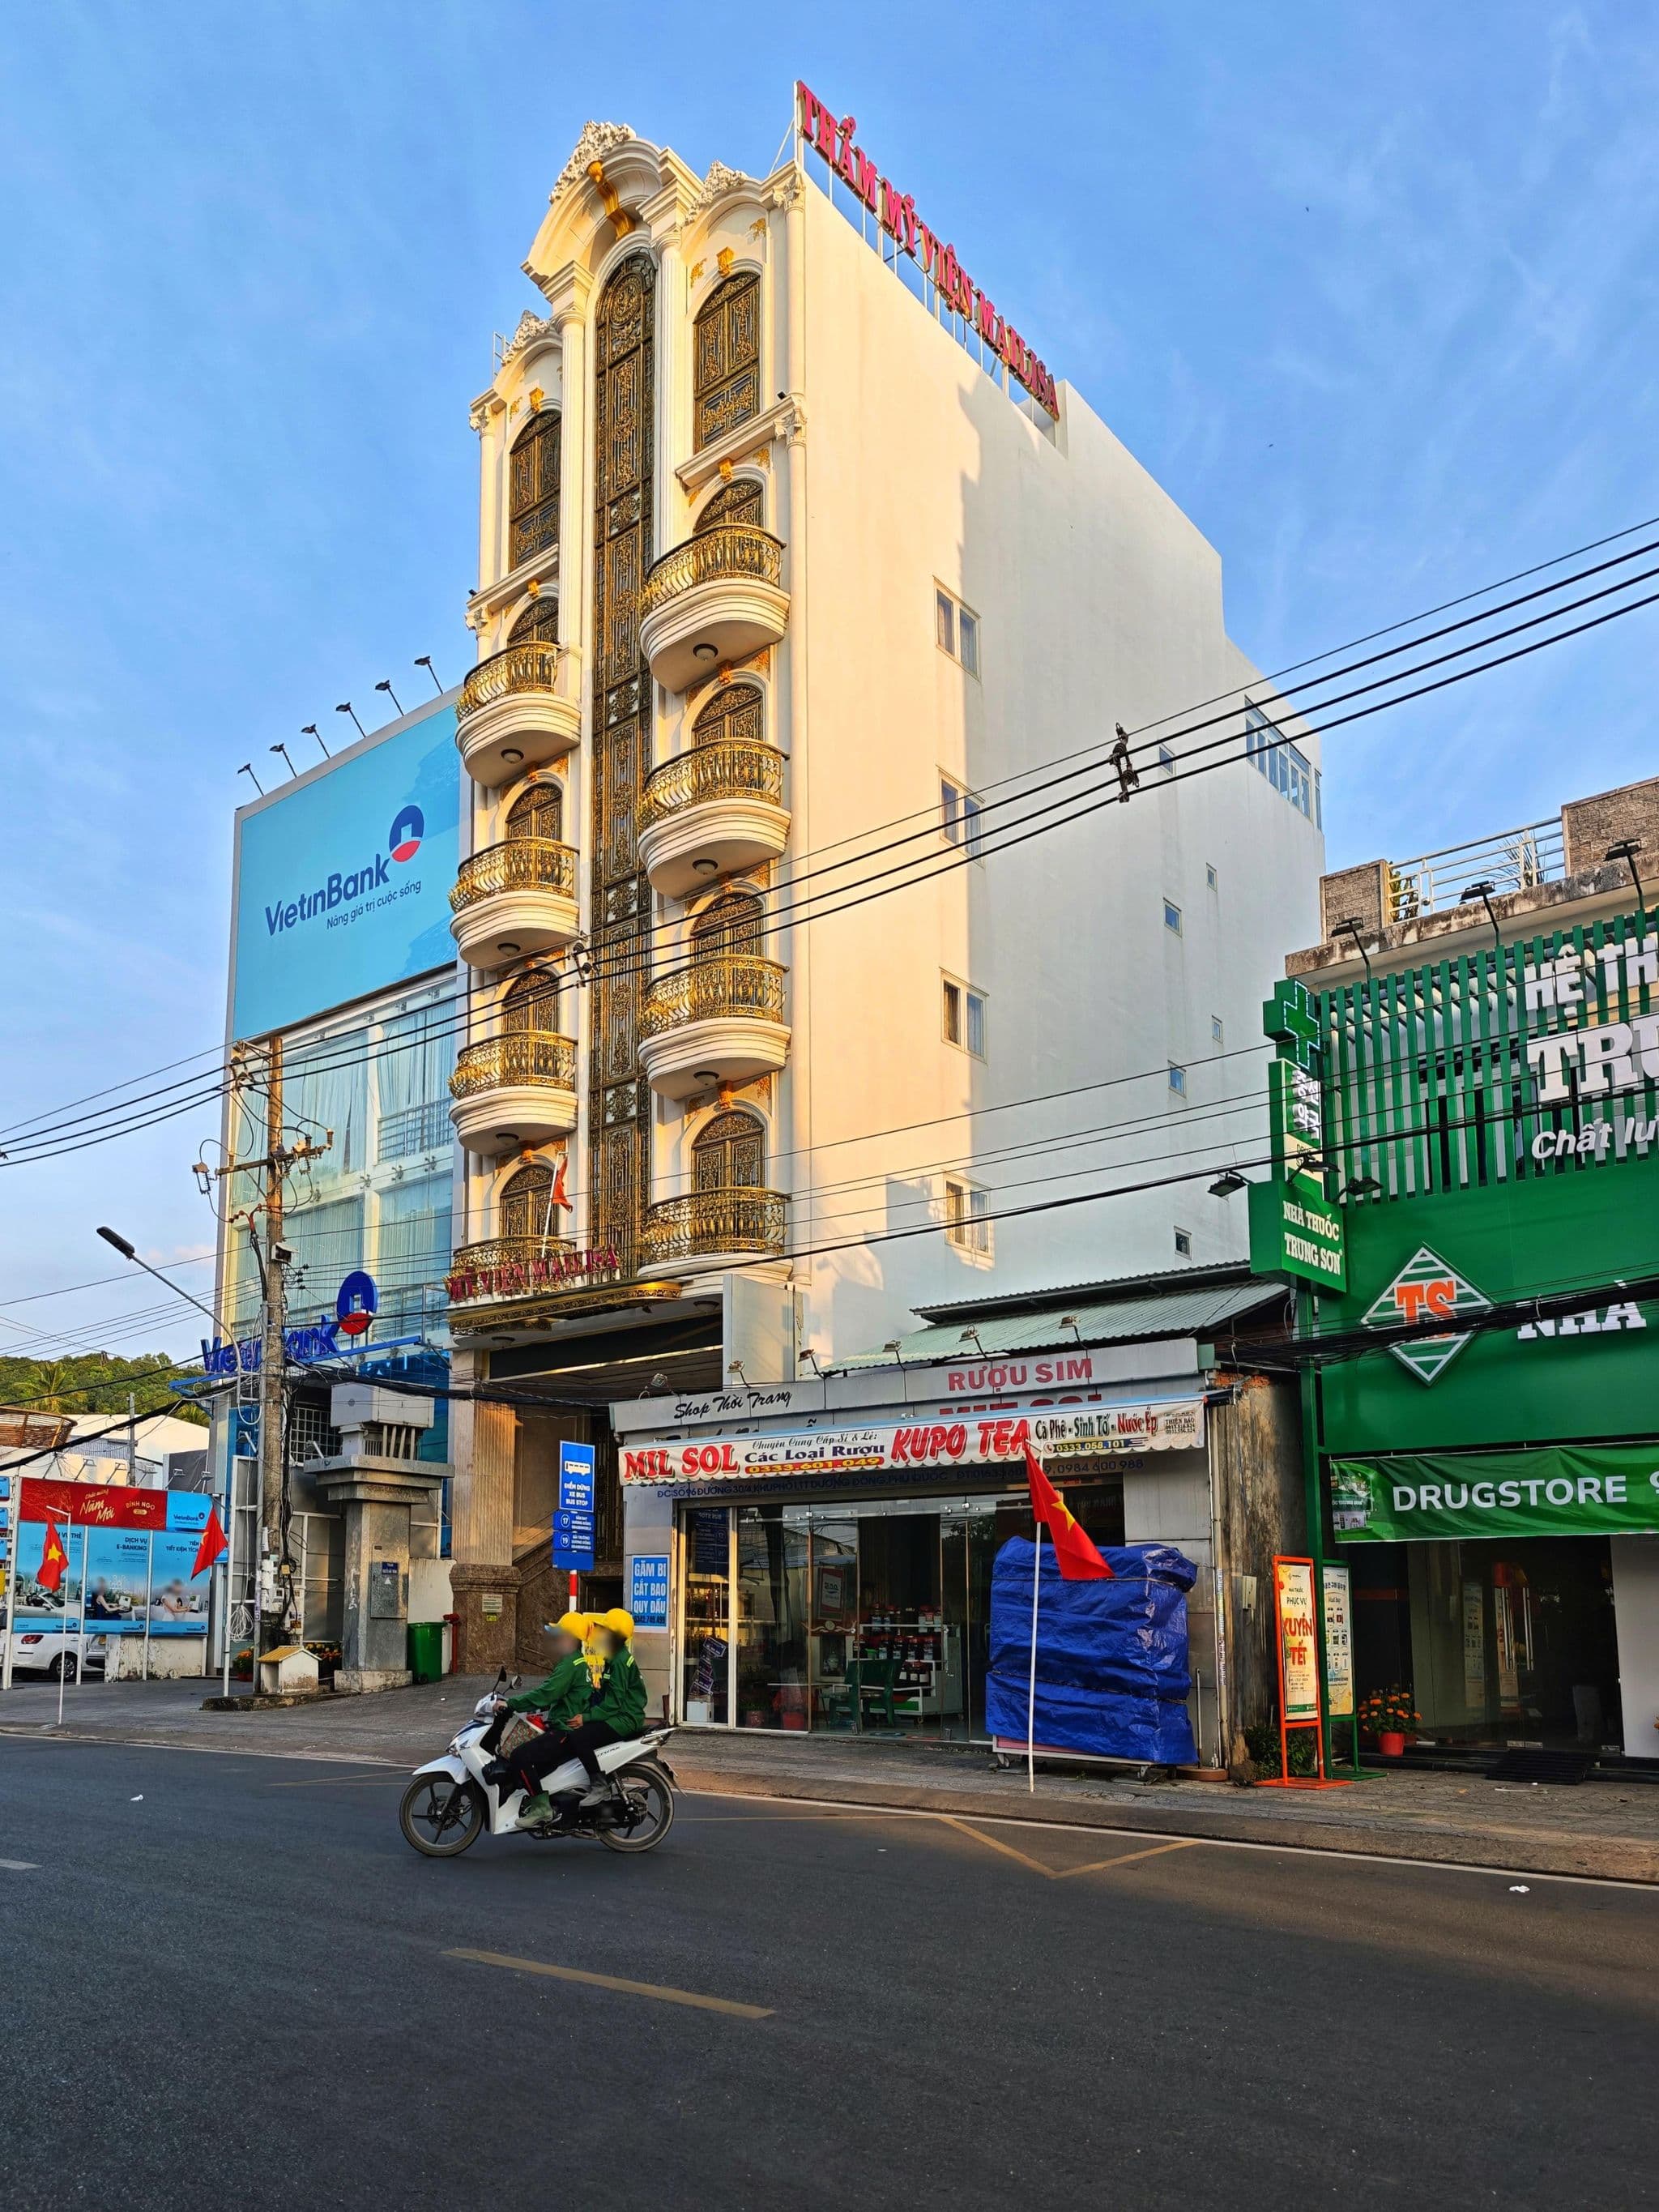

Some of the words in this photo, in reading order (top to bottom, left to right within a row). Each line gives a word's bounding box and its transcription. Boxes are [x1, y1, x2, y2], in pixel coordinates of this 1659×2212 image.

[975, 288, 1060, 421] MAILISA
[265, 853, 390, 937] VietinBank
[326, 912, 349, 930] Nâng
[350, 903, 364, 923] giá
[365, 898, 375, 912] trị
[377, 890, 398, 907] cuộc
[399, 880, 422, 898] sống
[1523, 943, 1584, 1017] HỆ
[1531, 1117, 1614, 1159] Chất
[1282, 1200, 1305, 1228] NHÀ
[1305, 1210, 1340, 1241] THUỐC
[1284, 1231, 1319, 1267] TRUNG
[948, 1364, 1028, 1393] RƯỢU
[1035, 1358, 1093, 1381] SIM
[673, 1402, 711, 1420] Shop
[712, 1393, 744, 1414] Thời
[748, 1390, 793, 1409] Trang
[891, 1424, 969, 1464] KUPO
[977, 1418, 1031, 1458] TEA
[1035, 1420, 1048, 1441] Cà
[1049, 1419, 1067, 1441] Phê
[1074, 1416, 1095, 1437] Sinh
[1096, 1413, 1111, 1437] Tố
[1117, 1412, 1144, 1434] Nước
[744, 1449, 782, 1463] Các
[785, 1445, 825, 1462] Loại
[832, 1442, 885, 1458] Rượu
[1056, 1439, 1126, 1453] 0333.058.101
[623, 1448, 676, 1481] MIL
[681, 1444, 741, 1476] SOL
[748, 1456, 881, 1475] 0333.601.049
[79, 1499, 105, 1517] Năm
[1392, 1475, 1628, 1513] DRUGSTORE
[562, 1517, 569, 1525] 17
[658, 1563, 666, 1577] BI
[650, 1582, 666, 1596] BAO
[633, 1600, 649, 1615] QUY
[1289, 1638, 1308, 1666] TẾT
